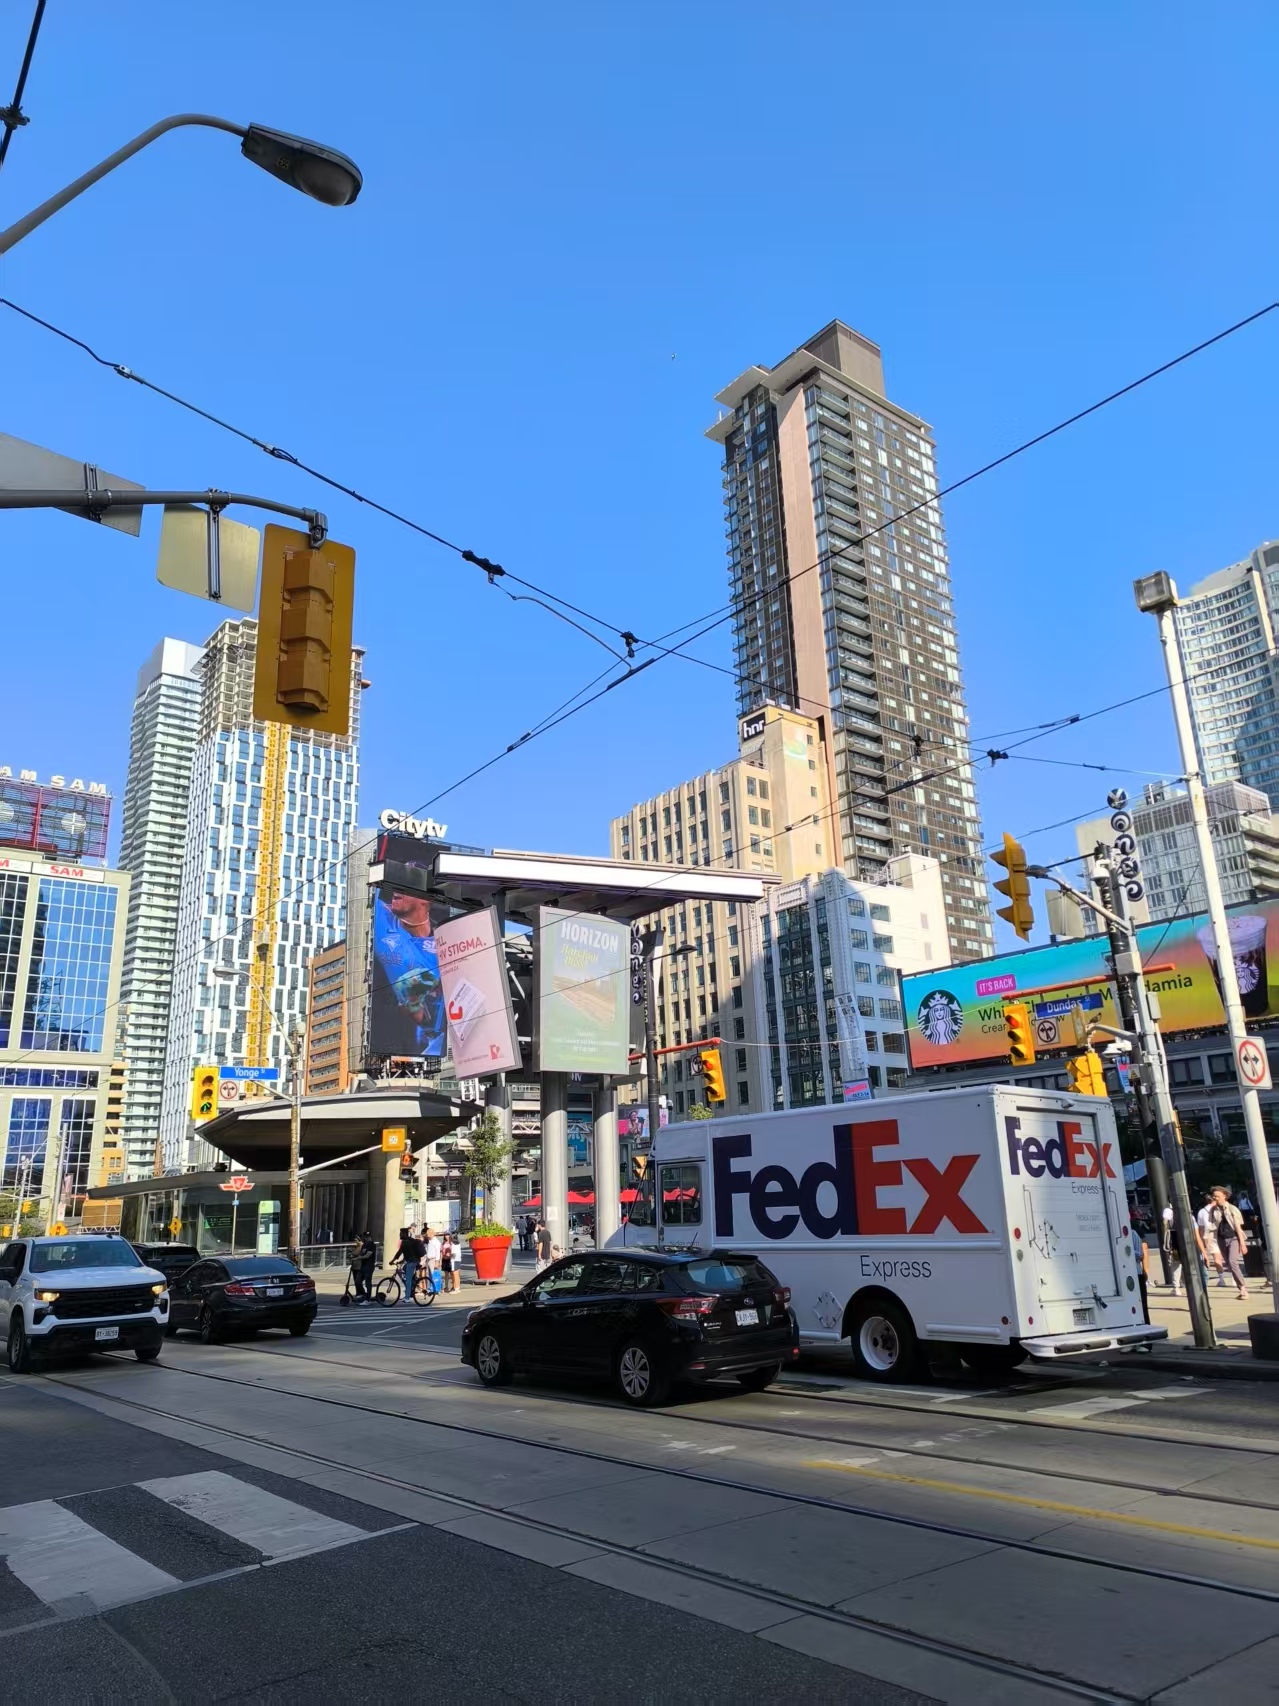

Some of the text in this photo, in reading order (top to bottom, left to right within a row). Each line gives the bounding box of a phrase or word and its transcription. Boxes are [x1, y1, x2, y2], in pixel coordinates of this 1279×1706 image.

[0, 766, 107, 794] AM SAM
[380, 808, 448, 839] Citytv
[50, 865, 84, 877] SAM
[447, 936, 487, 957] STIGMA.
[560, 921, 618, 952] HORIZON
[979, 978, 1014, 993] IT'S BACK
[978, 1005, 1005, 1021] Whi
[1046, 998, 1082, 1014] Dundas
[234, 1067, 260, 1079] Yonge
[1005, 1115, 1117, 1179] FedEx
[713, 1119, 988, 1240] FedEx
[1071, 1182, 1100, 1194] Express
[860, 1255, 932, 1282] Express
